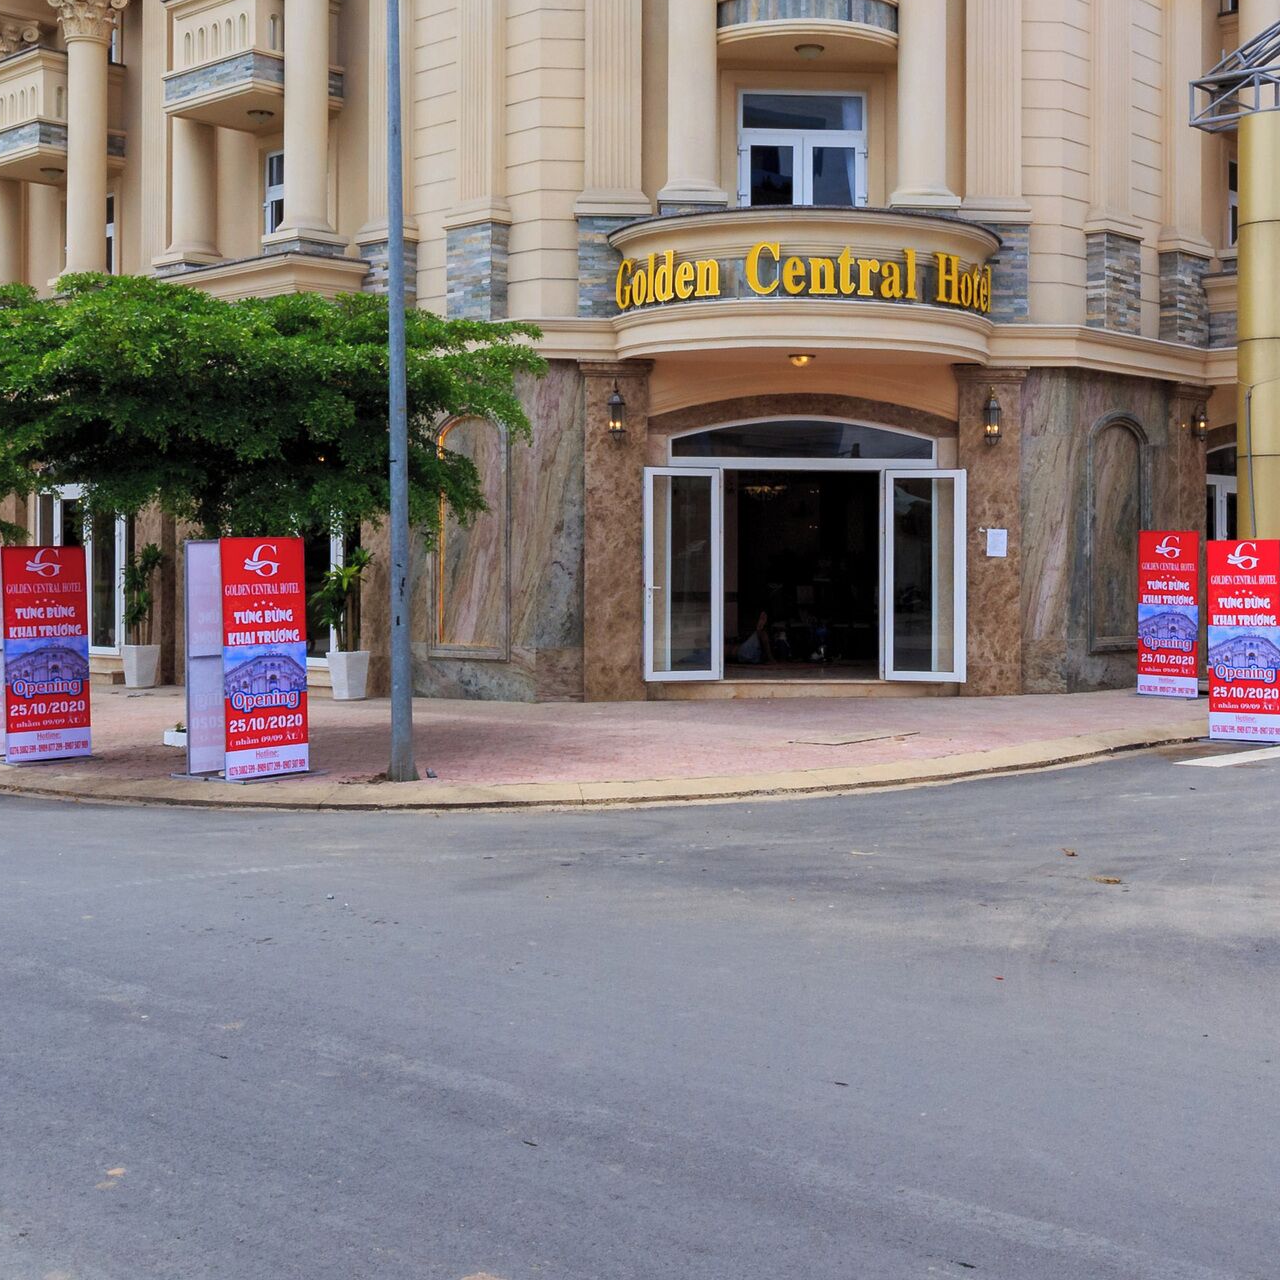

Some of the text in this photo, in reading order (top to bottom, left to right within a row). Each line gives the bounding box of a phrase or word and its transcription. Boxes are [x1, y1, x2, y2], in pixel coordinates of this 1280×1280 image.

[615, 240, 993, 313] Golden Central Hotel
[1211, 575, 1277, 585] GOLDEN CENTRAL HOTEL
[6, 582, 82, 594] GOLDEN CENTRAL HOTEL
[224, 582, 300, 596] GOLDEN CENTRAL HOTEL
[15, 606, 45, 619] TƯNG
[234, 609, 263, 624] TƯNG
[1212, 615, 1236, 625] KHAI
[9, 625, 37, 638] KHAI
[228, 631, 256, 645] KHAI
[1143, 636, 1192, 650] Opening
[1141, 653, 1194, 665] 25/10/2020
[1216, 666, 1275, 683] Opening
[13, 679, 83, 698] Opening
[1213, 686, 1279, 699] 25/10/2020
[232, 689, 299, 712] Opening
[10, 700, 86, 717] 25/10/2020
[229, 713, 303, 733] 25/10/2020
